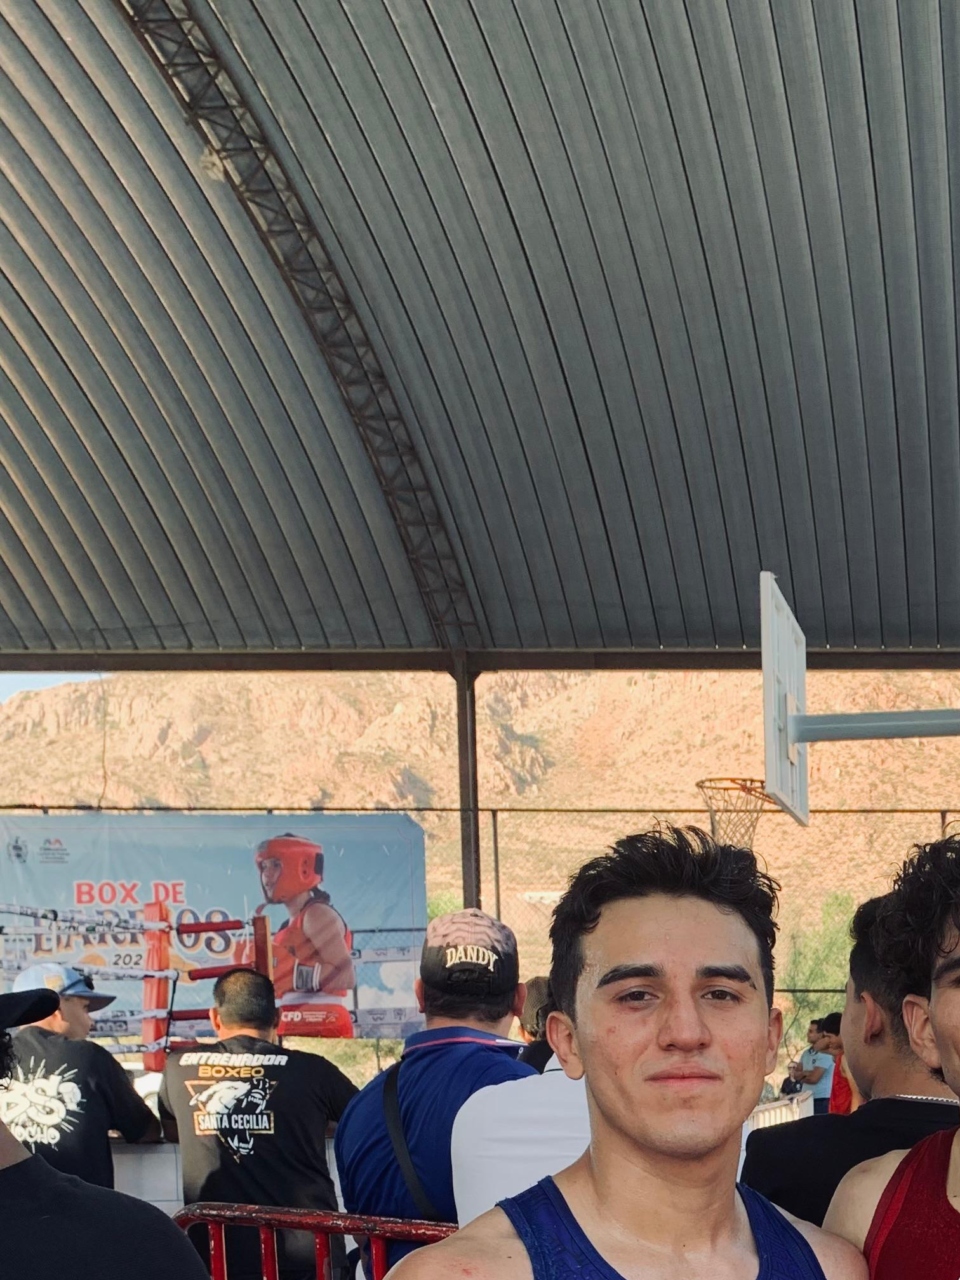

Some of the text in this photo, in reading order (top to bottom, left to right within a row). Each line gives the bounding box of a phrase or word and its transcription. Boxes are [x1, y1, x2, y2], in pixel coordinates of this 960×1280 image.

[75, 882, 185, 905] BOX DE
[112, 953, 143, 967] 202
[445, 944, 498, 972] DANDY
[281, 1011, 302, 1023] CFD
[179, 1052, 288, 1067] ENTRENADOR
[198, 1066, 265, 1078] BOXEO
[199, 1114, 270, 1130] SANTA CECILIA
